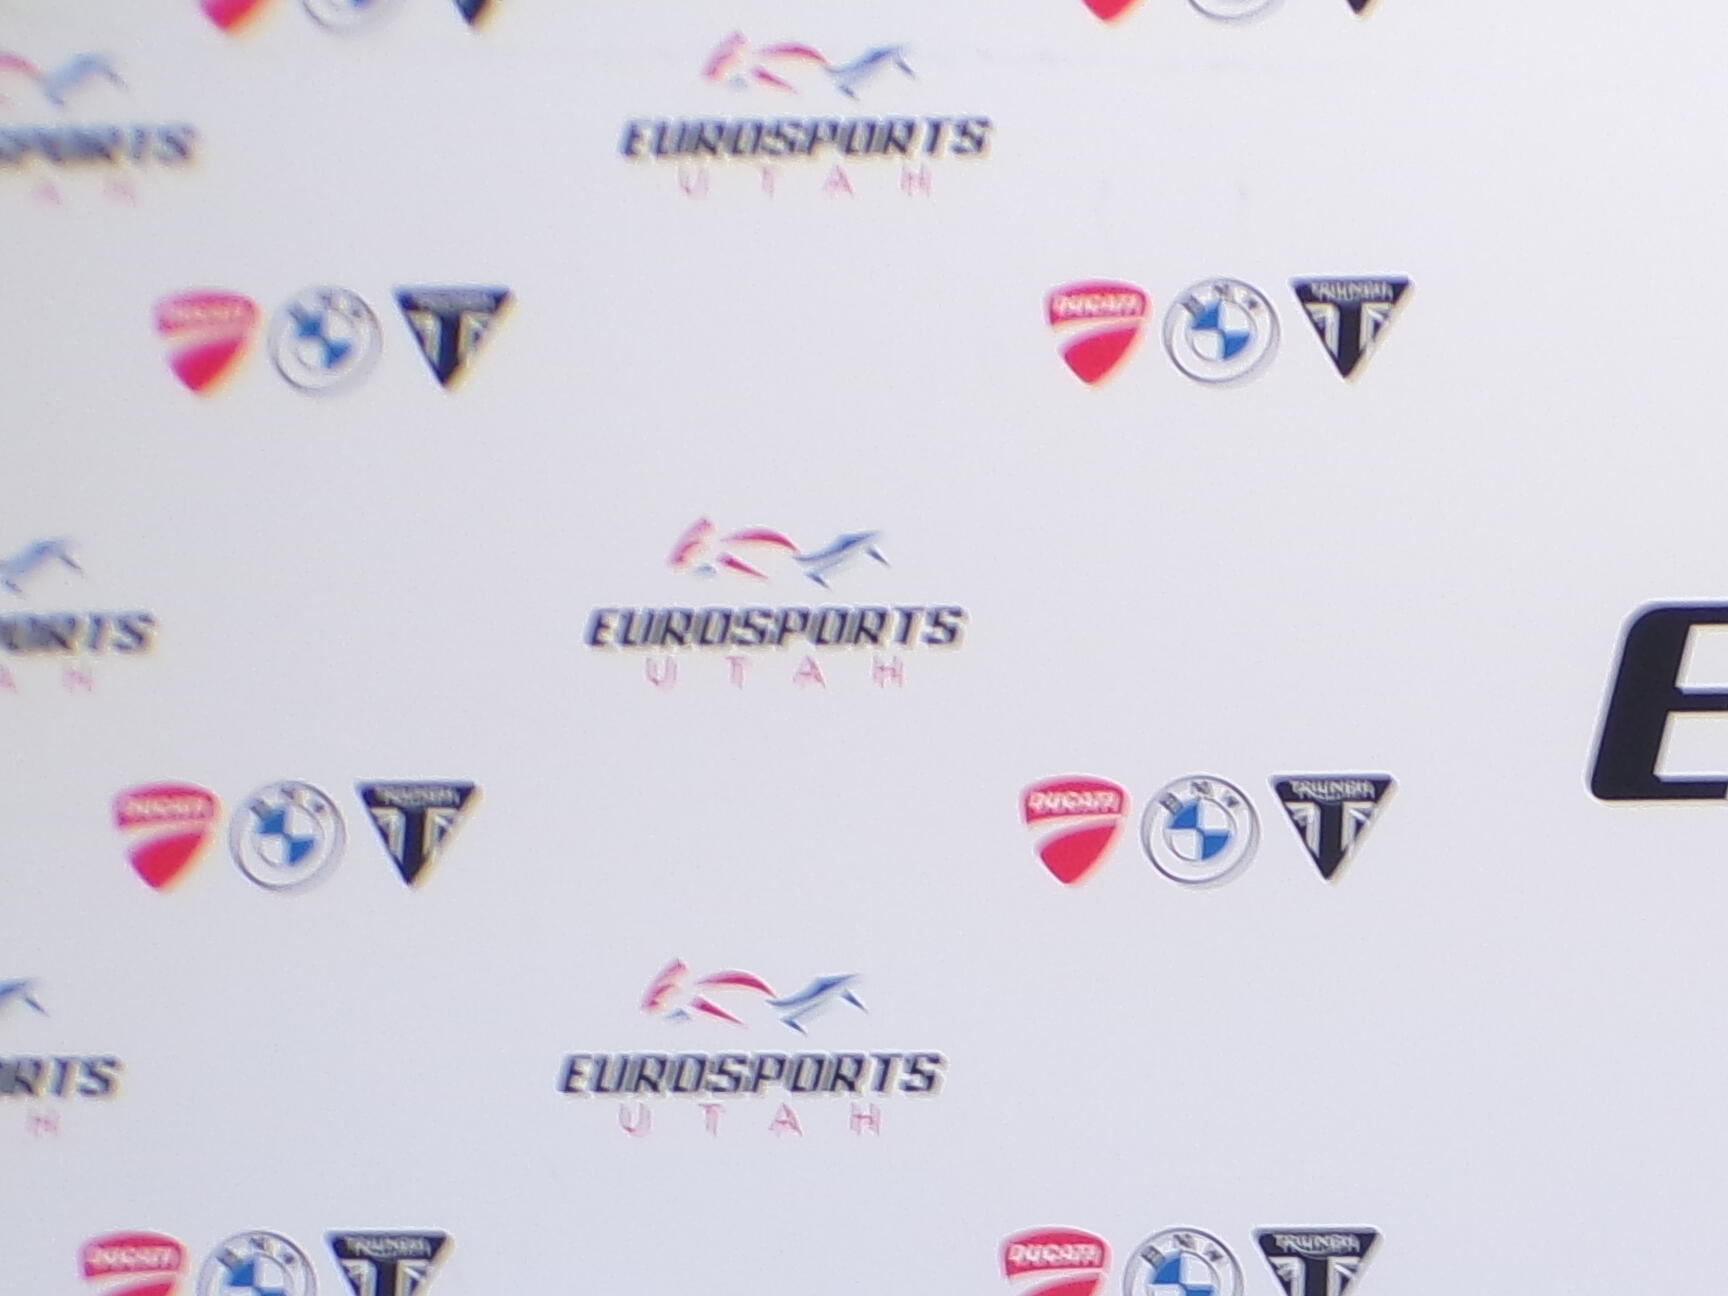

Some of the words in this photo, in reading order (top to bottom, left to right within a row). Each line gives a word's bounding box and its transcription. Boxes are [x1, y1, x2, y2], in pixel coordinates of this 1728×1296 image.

[586, 605, 965, 650] EUROSPORTS
[557, 1051, 944, 1096] EUROSPORTS
[621, 1102, 882, 1138] UTAH
